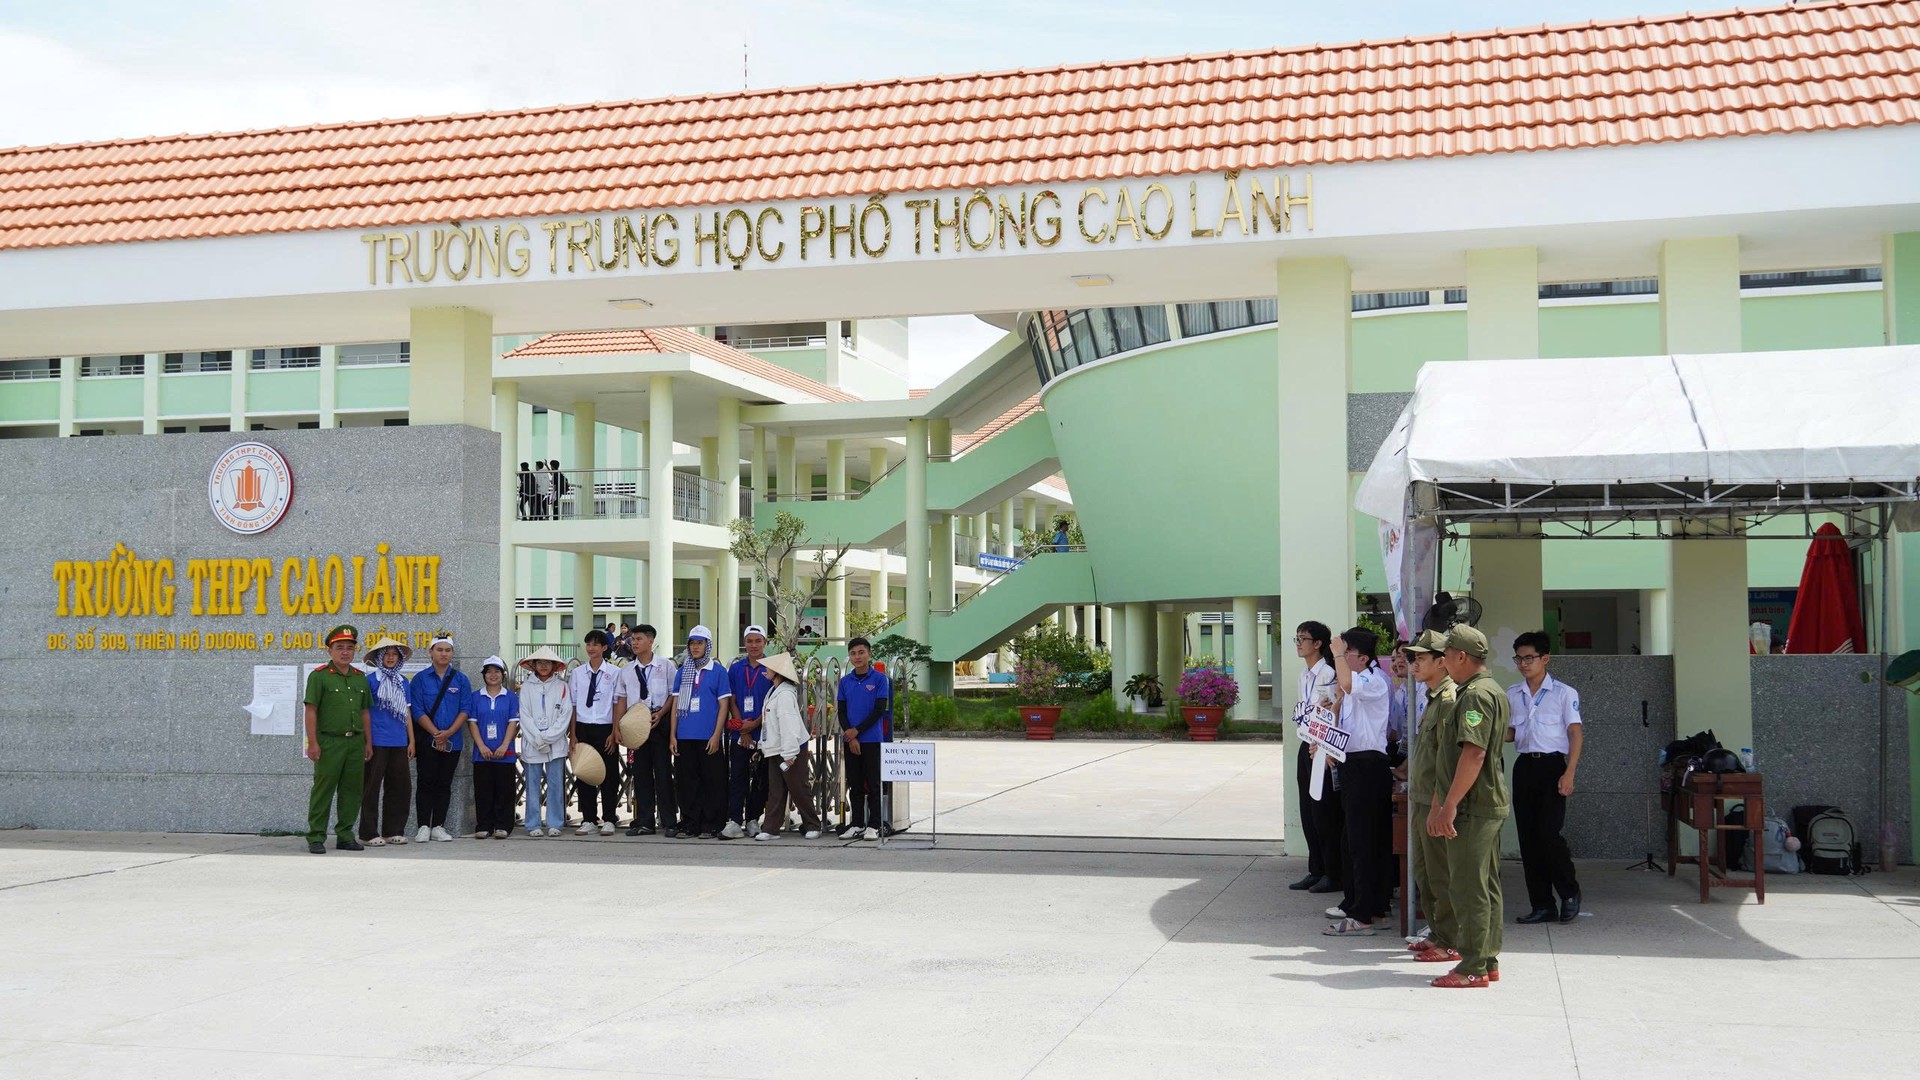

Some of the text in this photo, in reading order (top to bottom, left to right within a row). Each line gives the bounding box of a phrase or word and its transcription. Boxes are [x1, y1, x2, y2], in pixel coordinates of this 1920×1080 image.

[360, 221, 531, 286] TRƯỜNG
[541, 212, 680, 275] TRUNG
[693, 207, 786, 272] HỌC
[904, 188, 1063, 254] THÔNG
[1078, 182, 1175, 244] CAO
[236, 447, 256, 456] THPT
[52, 542, 177, 617] TRƯỜNG
[187, 557, 273, 616] THPT
[280, 554, 344, 616] CAO
[47, 633, 71, 650] ĐC:
[75, 626, 97, 650] SỐ
[100, 633, 130, 652] 309,
[135, 629, 176, 650] THIÊN
[179, 629, 201, 654] HỘ
[205, 630, 260, 652] DƯƠNG,
[264, 632, 277, 649] P.
[282, 632, 313, 650] CAO
